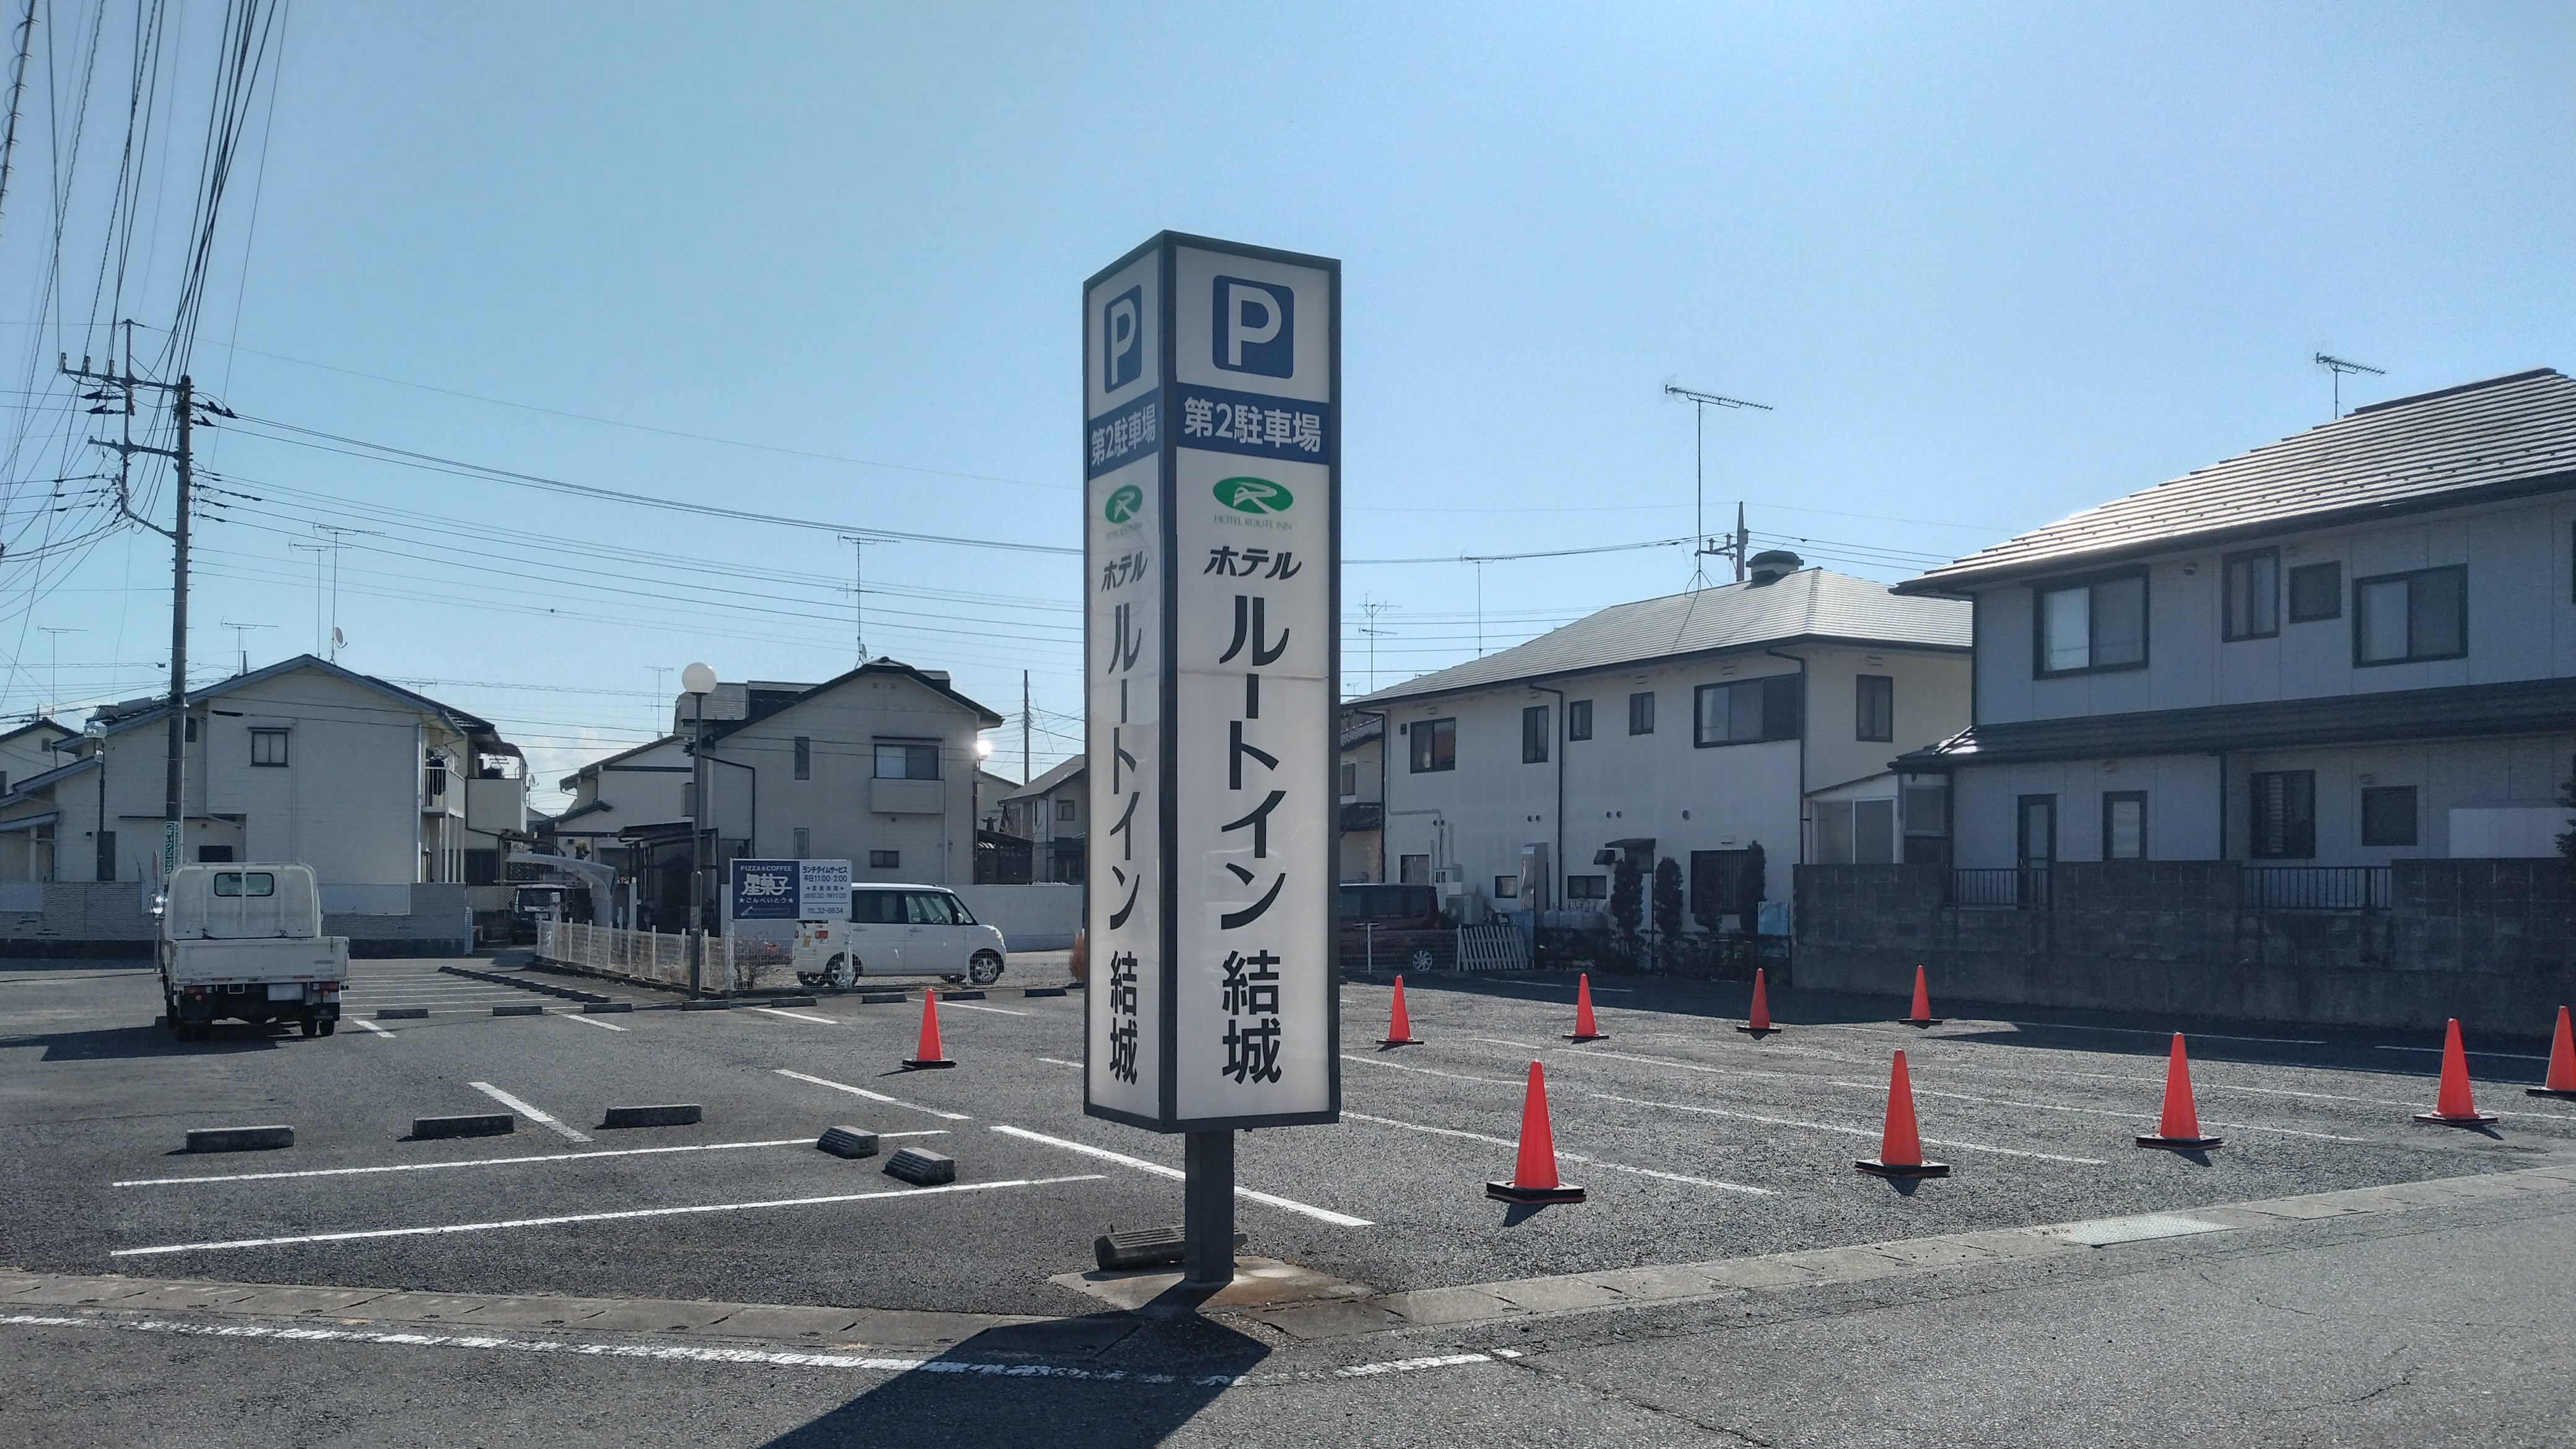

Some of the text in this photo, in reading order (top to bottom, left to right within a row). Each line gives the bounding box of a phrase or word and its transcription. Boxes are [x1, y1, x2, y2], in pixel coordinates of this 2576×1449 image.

[1110, 298, 1136, 385] P
[1228, 282, 1282, 366] P
[1091, 403, 1156, 466] 第2駐車場
[1183, 396, 1322, 453] 第2駐車場
[1214, 514, 1292, 530] HOTEL ROUTE INN
[1101, 550, 1147, 593] ホテル
[1204, 546, 1302, 580] ホテル
[802, 866, 848, 874] ランチタイムサービス
[1109, 950, 1138, 1086] 結城
[1222, 949, 1282, 1085] 結城
